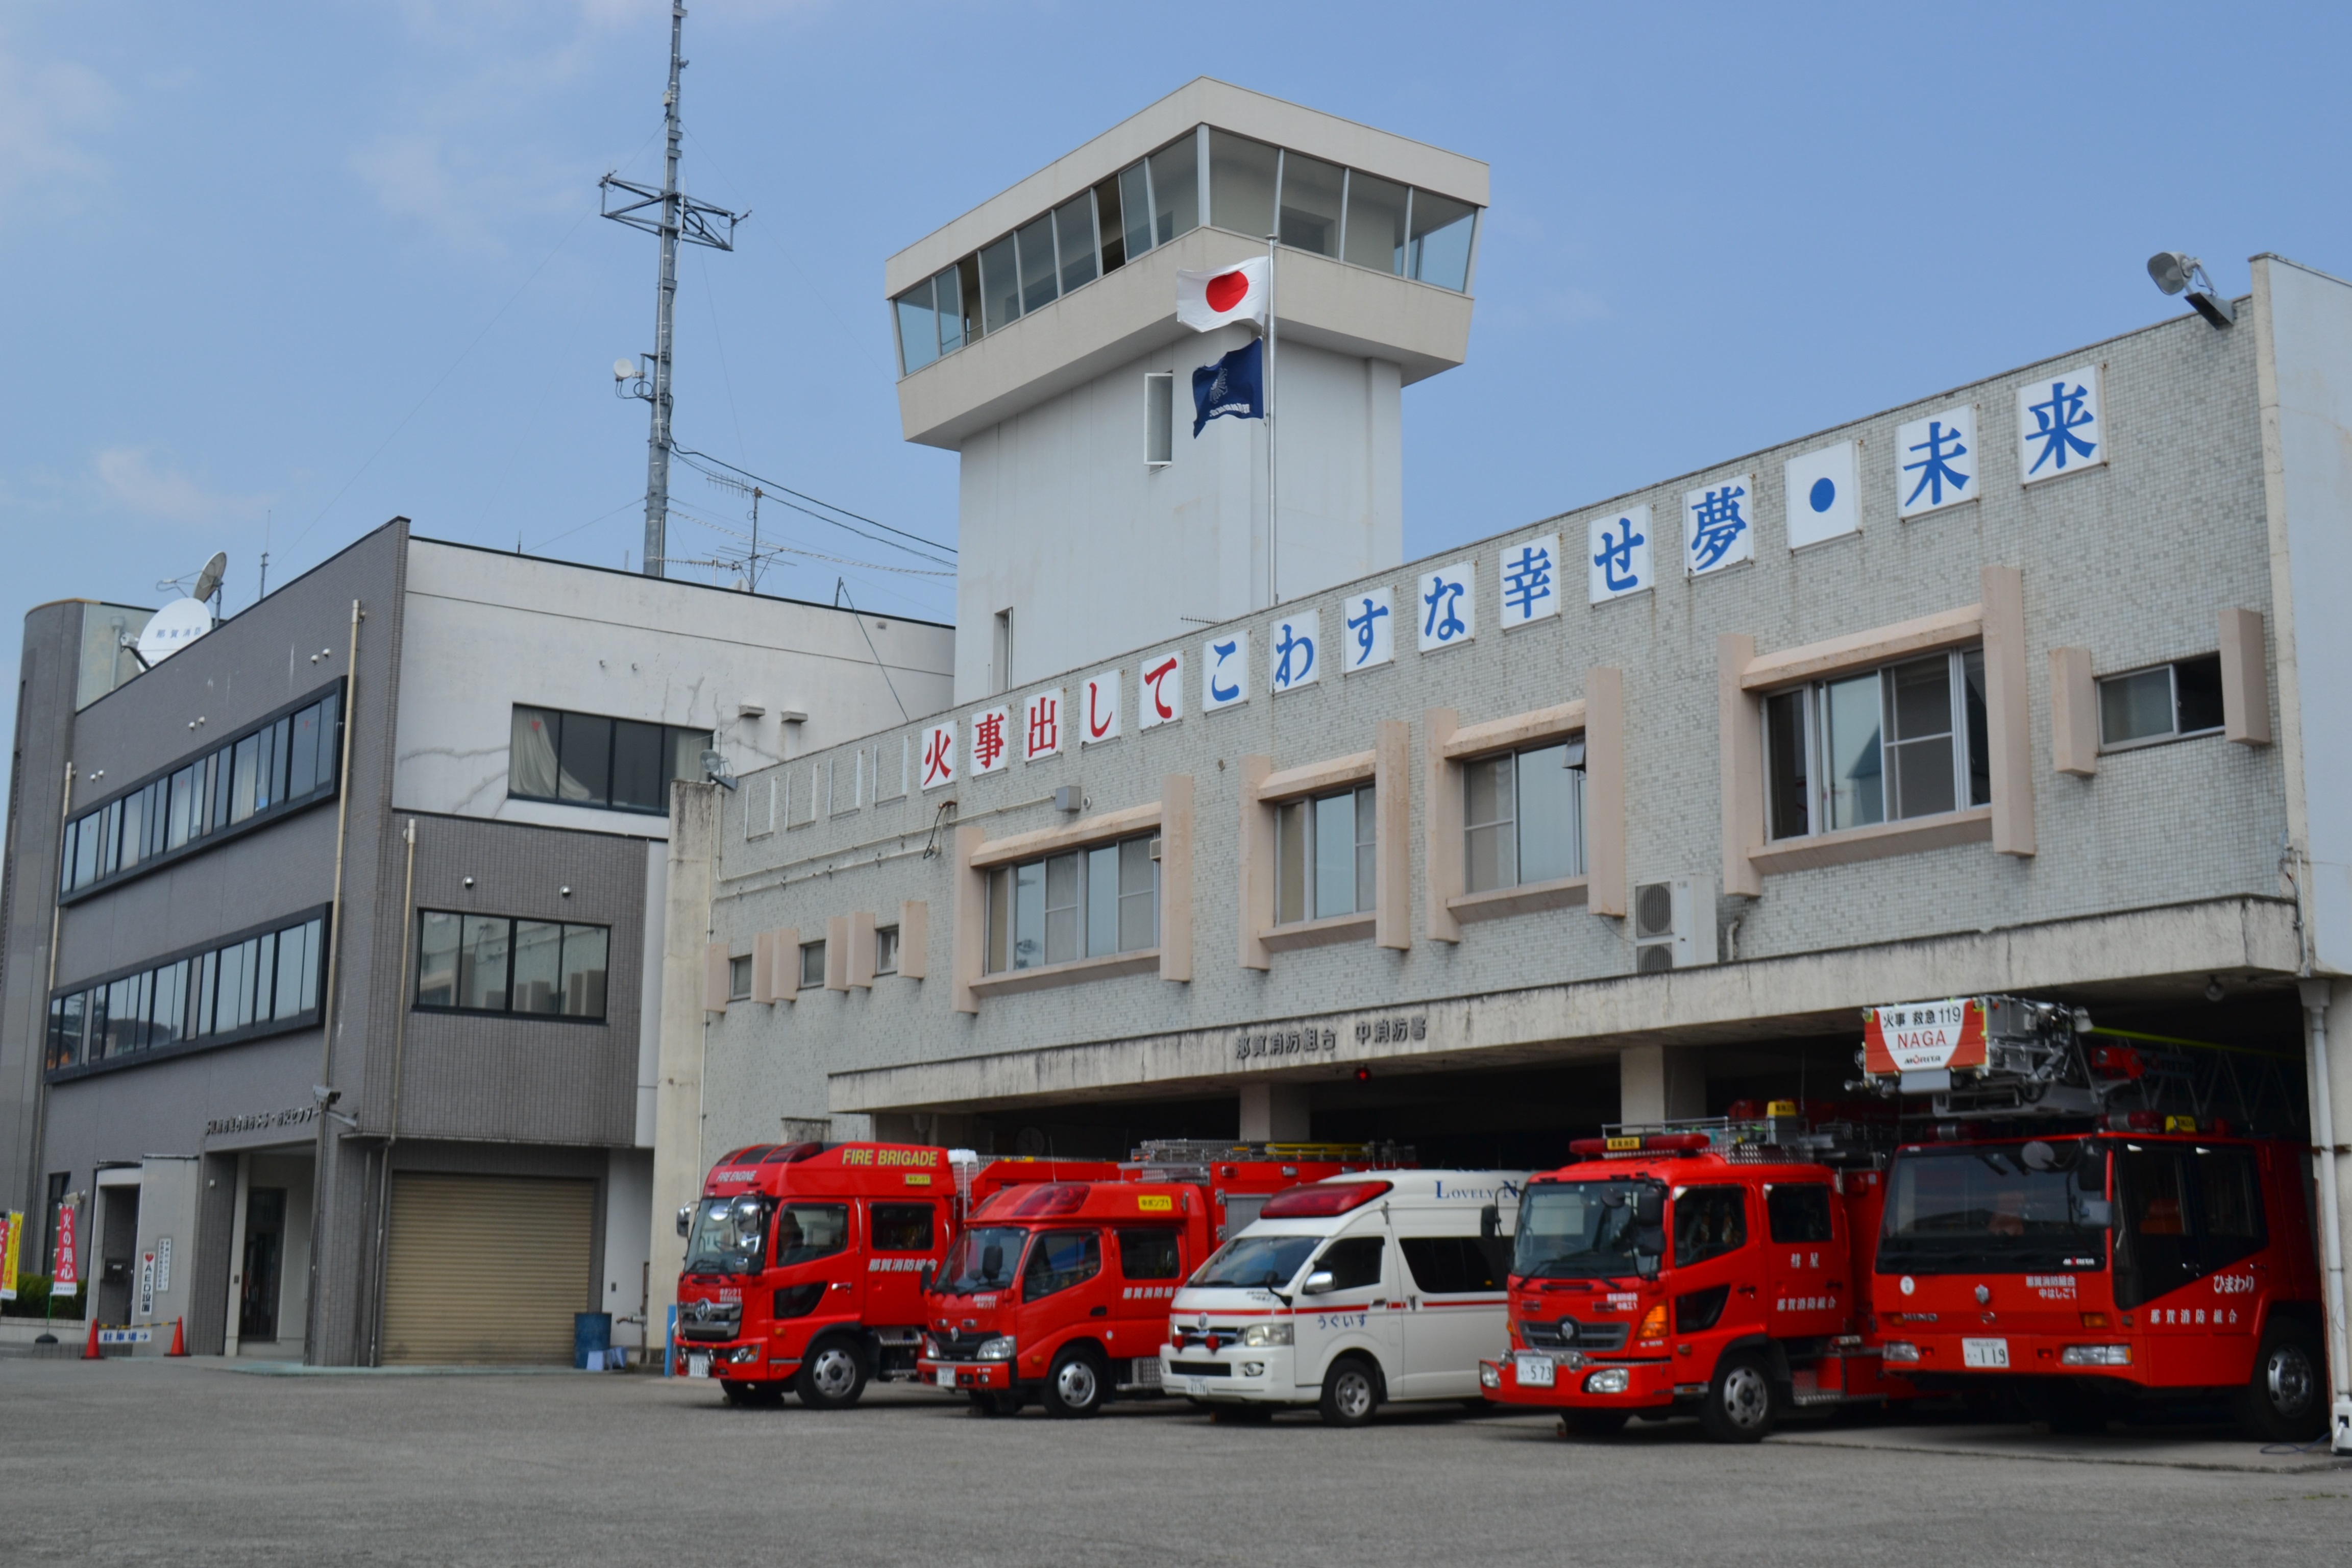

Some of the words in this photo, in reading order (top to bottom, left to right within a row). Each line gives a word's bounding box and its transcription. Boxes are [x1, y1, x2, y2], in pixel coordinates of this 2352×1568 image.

[1883, 1011, 1906, 1028] 火事
[1912, 1009, 1936, 1025] 救急
[1939, 1006, 1962, 1024] 119
[1897, 1029, 1947, 1049] NAGA
[1904, 1055, 1942, 1065] MORITA
[842, 1148, 874, 1165] FIRE
[877, 1149, 939, 1167] BRIGADE
[716, 1171, 730, 1182] FIRE
[730, 1170, 757, 1182] ENGINE
[60, 1212, 74, 1280] 火の用心
[2063, 1255, 2095, 1266] MORITA
[2213, 1274, 2255, 1294] ひまわり
[1318, 1312, 1367, 1330] うぐいす
[2150, 1308, 2238, 1324] 那賀消防組合
